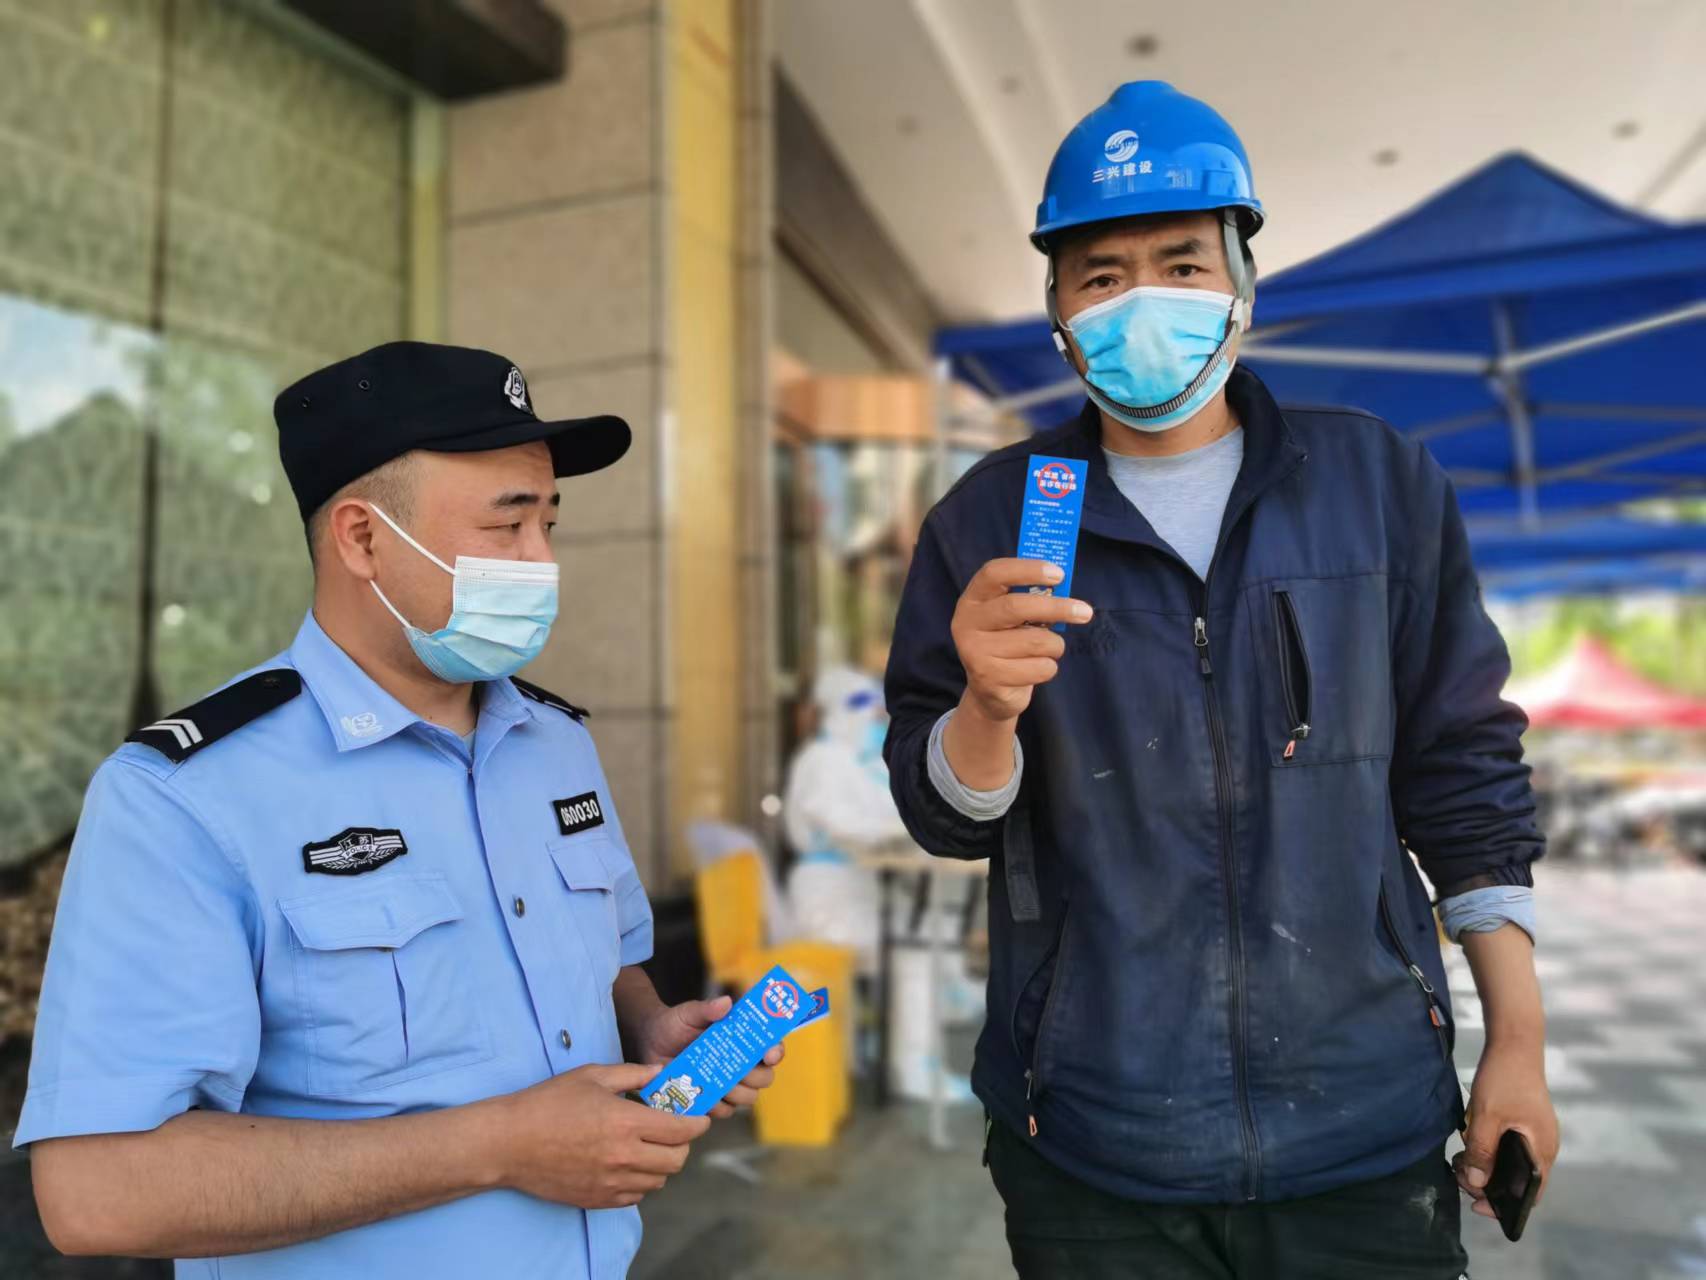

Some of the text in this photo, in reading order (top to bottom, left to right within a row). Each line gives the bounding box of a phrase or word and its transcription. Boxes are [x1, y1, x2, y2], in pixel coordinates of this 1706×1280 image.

[1092, 160, 1153, 183] 三兴建设
[561, 799, 600, 826] 060030
[345, 845, 373, 857] POLICE
